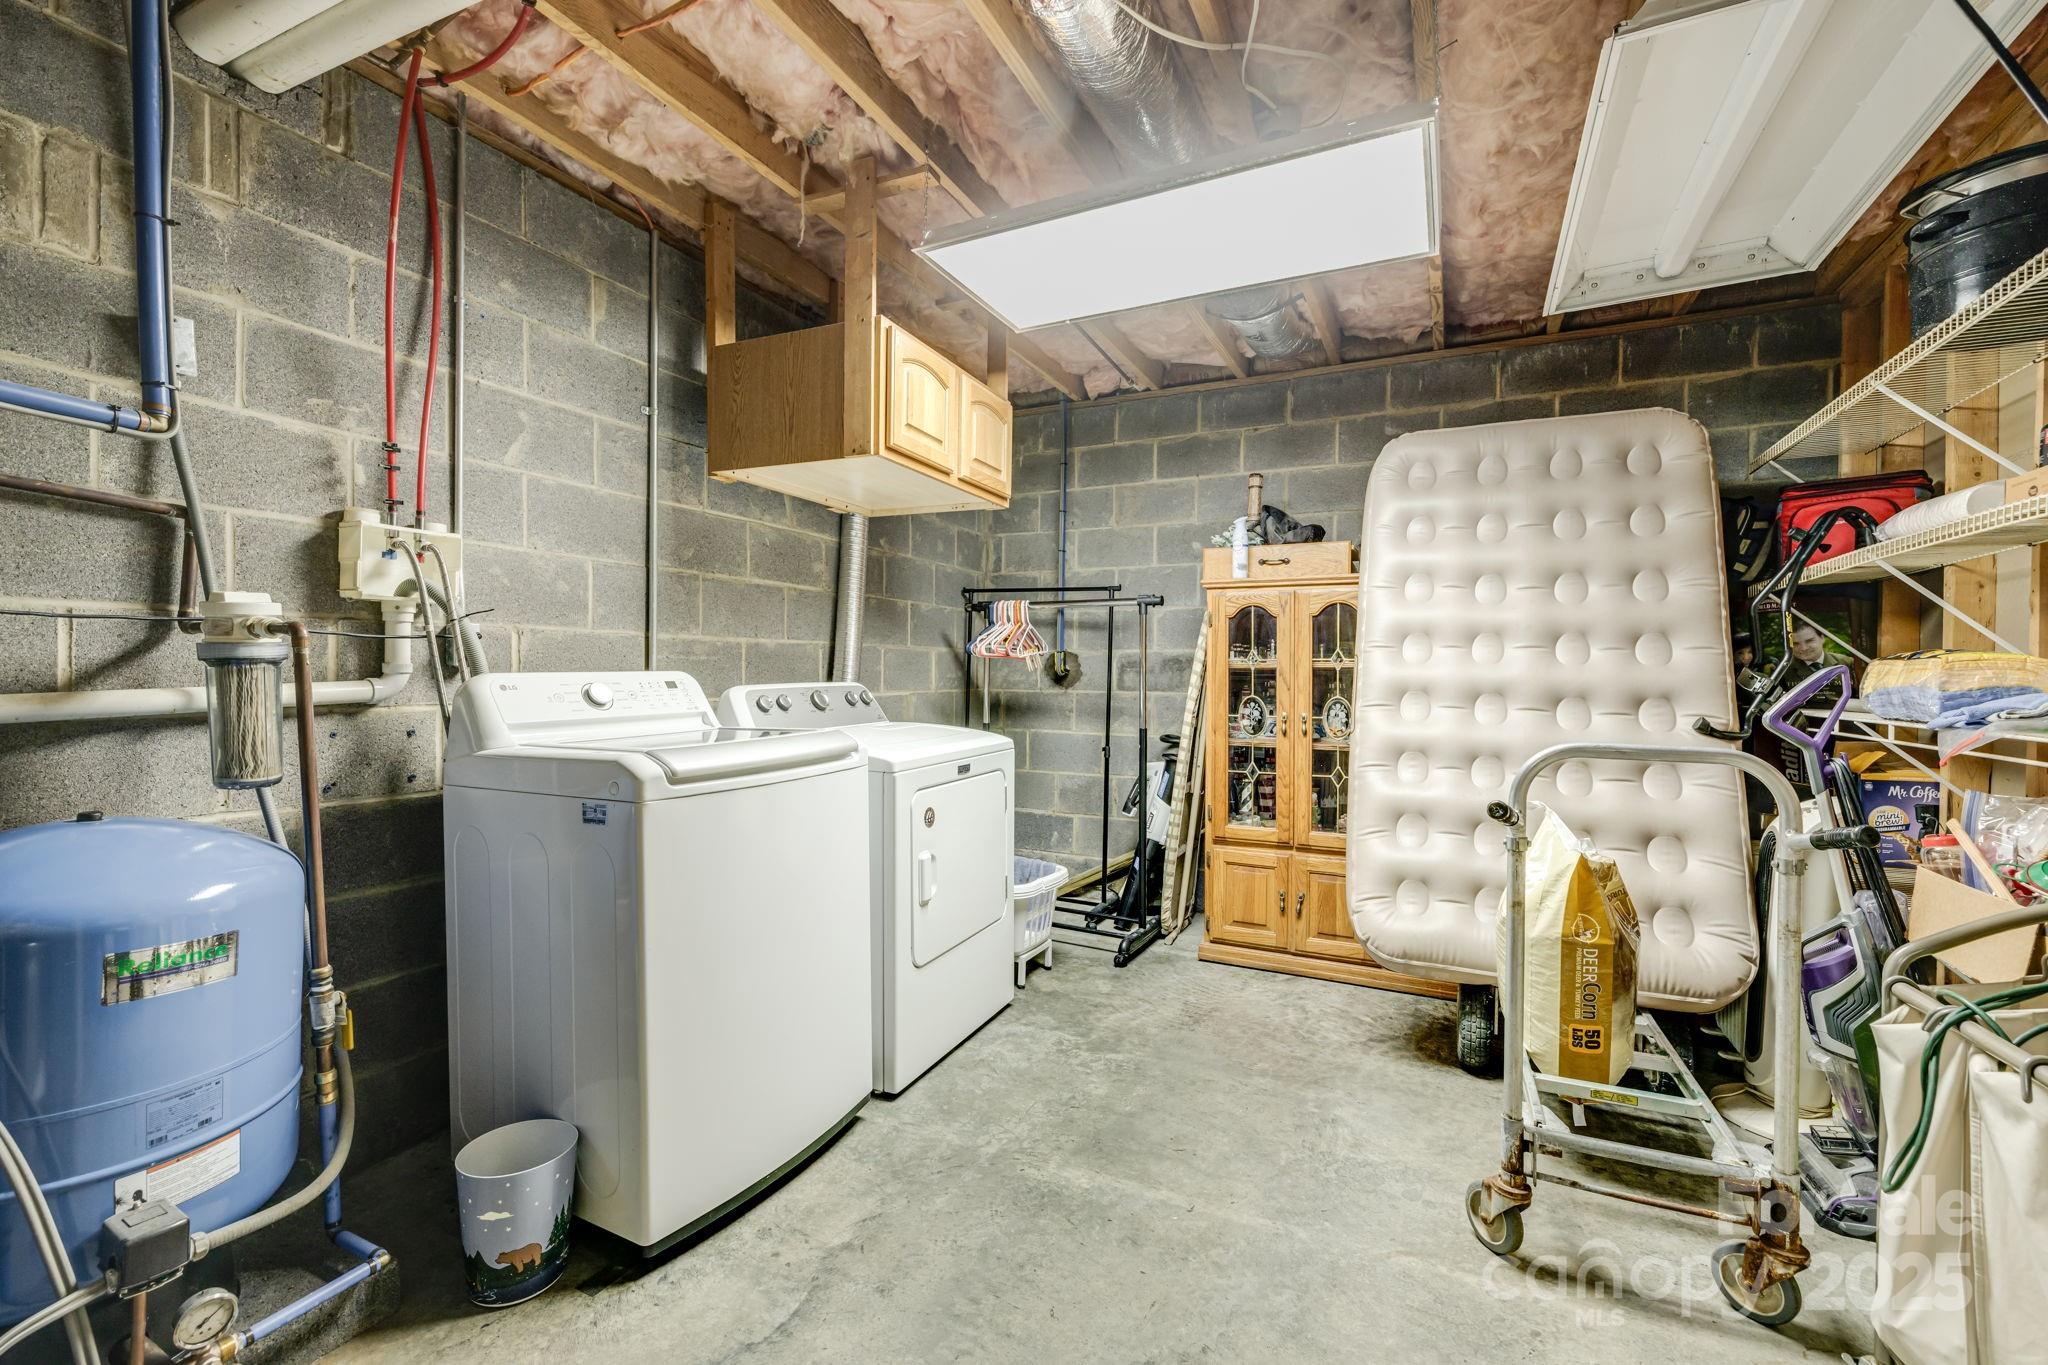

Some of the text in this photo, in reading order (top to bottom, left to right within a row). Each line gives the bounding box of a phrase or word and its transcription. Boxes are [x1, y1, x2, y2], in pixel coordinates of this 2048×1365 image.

[1888, 786, 1908, 799] Mr.
[1875, 815, 1904, 826] brew!
[1876, 810, 1900, 820] mini
[117, 943, 229, 978] Reliance
[1582, 948, 1602, 1020] DEERCorn
[1572, 1027, 1584, 1048] LBS
[1584, 1029, 1600, 1050] 50
